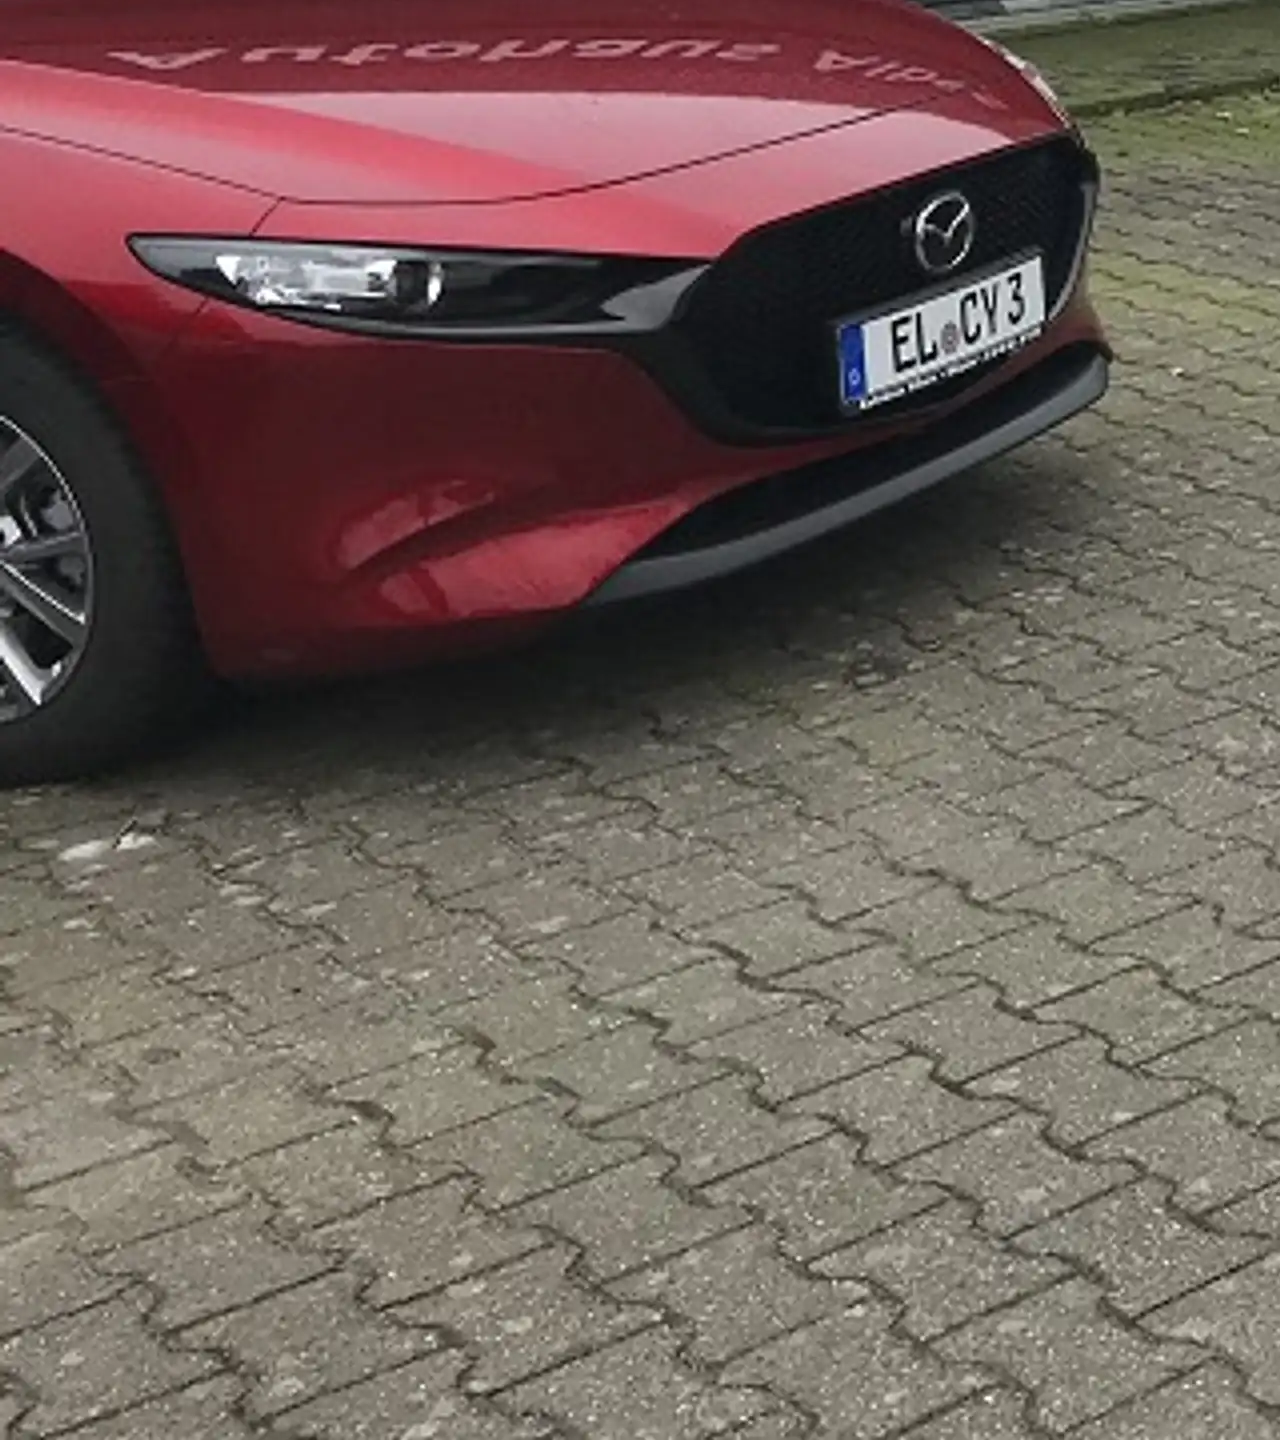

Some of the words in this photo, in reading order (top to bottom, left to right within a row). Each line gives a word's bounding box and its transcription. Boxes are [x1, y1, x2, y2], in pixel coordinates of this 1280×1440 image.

[889, 312, 938, 373] EL
[958, 280, 1001, 345] CY
[1007, 271, 1026, 326] 3
